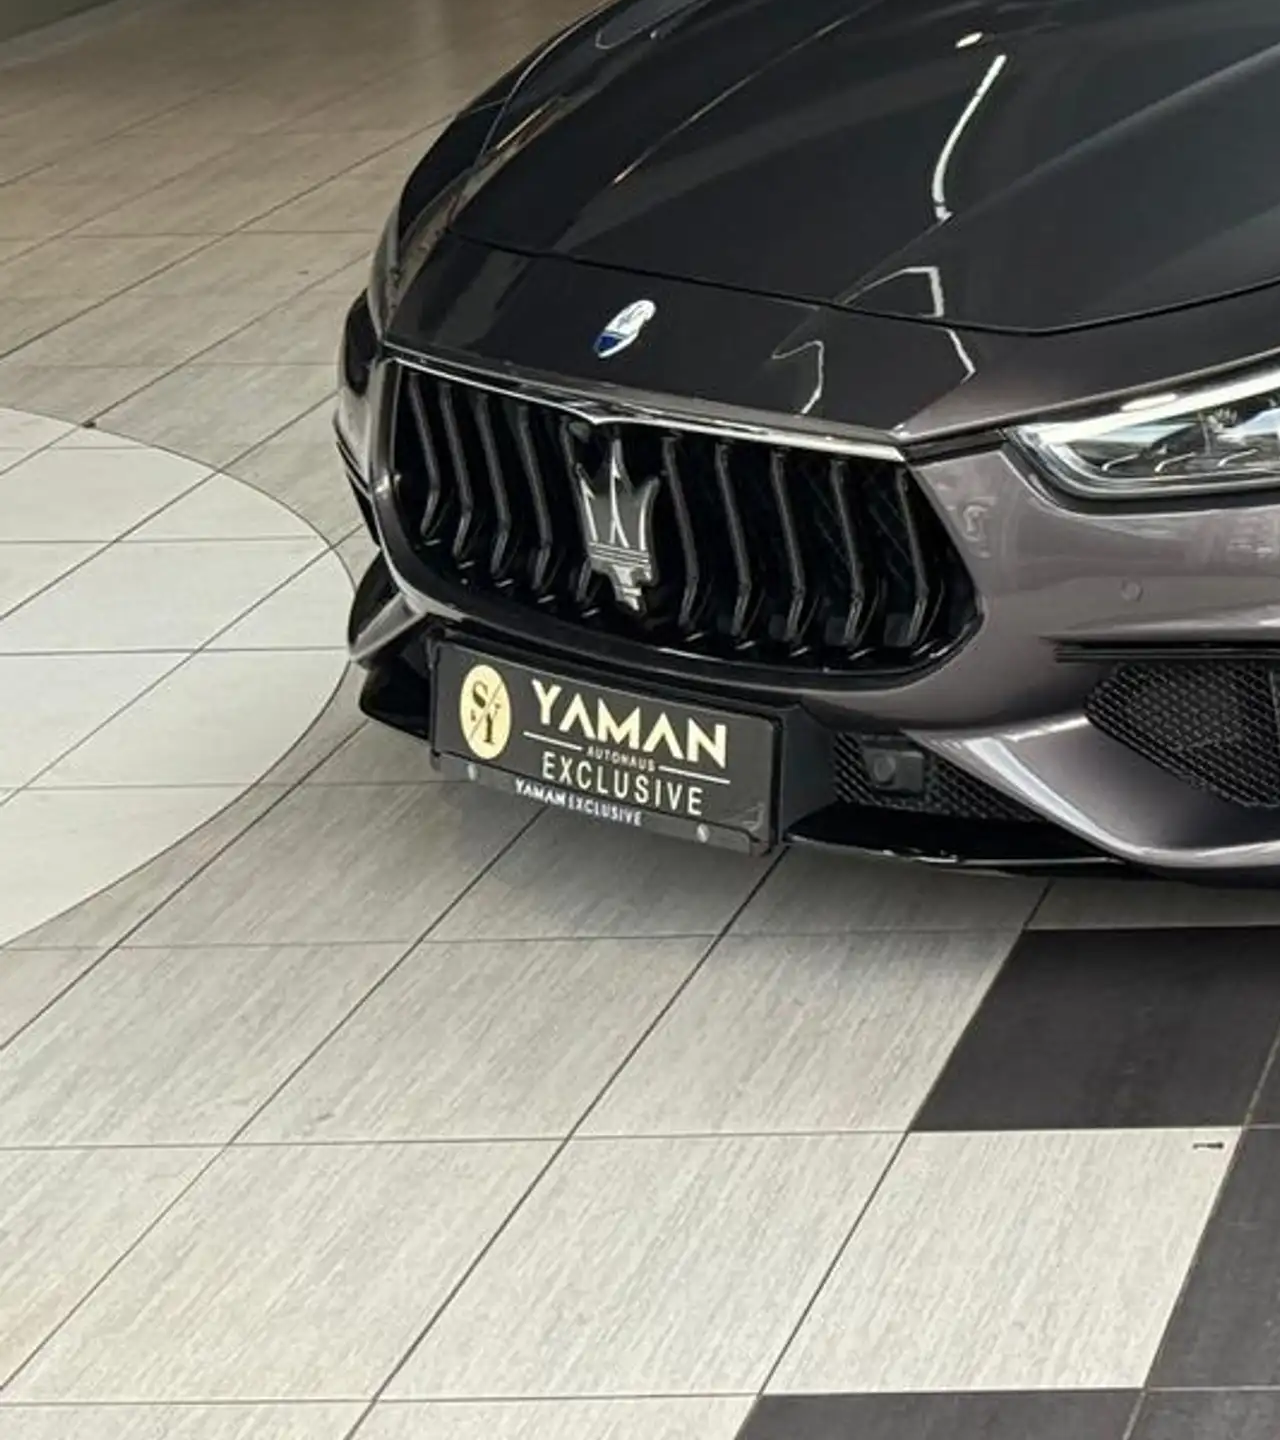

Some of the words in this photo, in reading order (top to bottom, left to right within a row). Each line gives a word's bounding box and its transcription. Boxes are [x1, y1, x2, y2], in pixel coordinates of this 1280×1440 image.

[531, 679, 727, 769] YAMAN
[542, 751, 703, 816] EXCLUSIVE
[586, 745, 655, 772] AUTOHAUS
